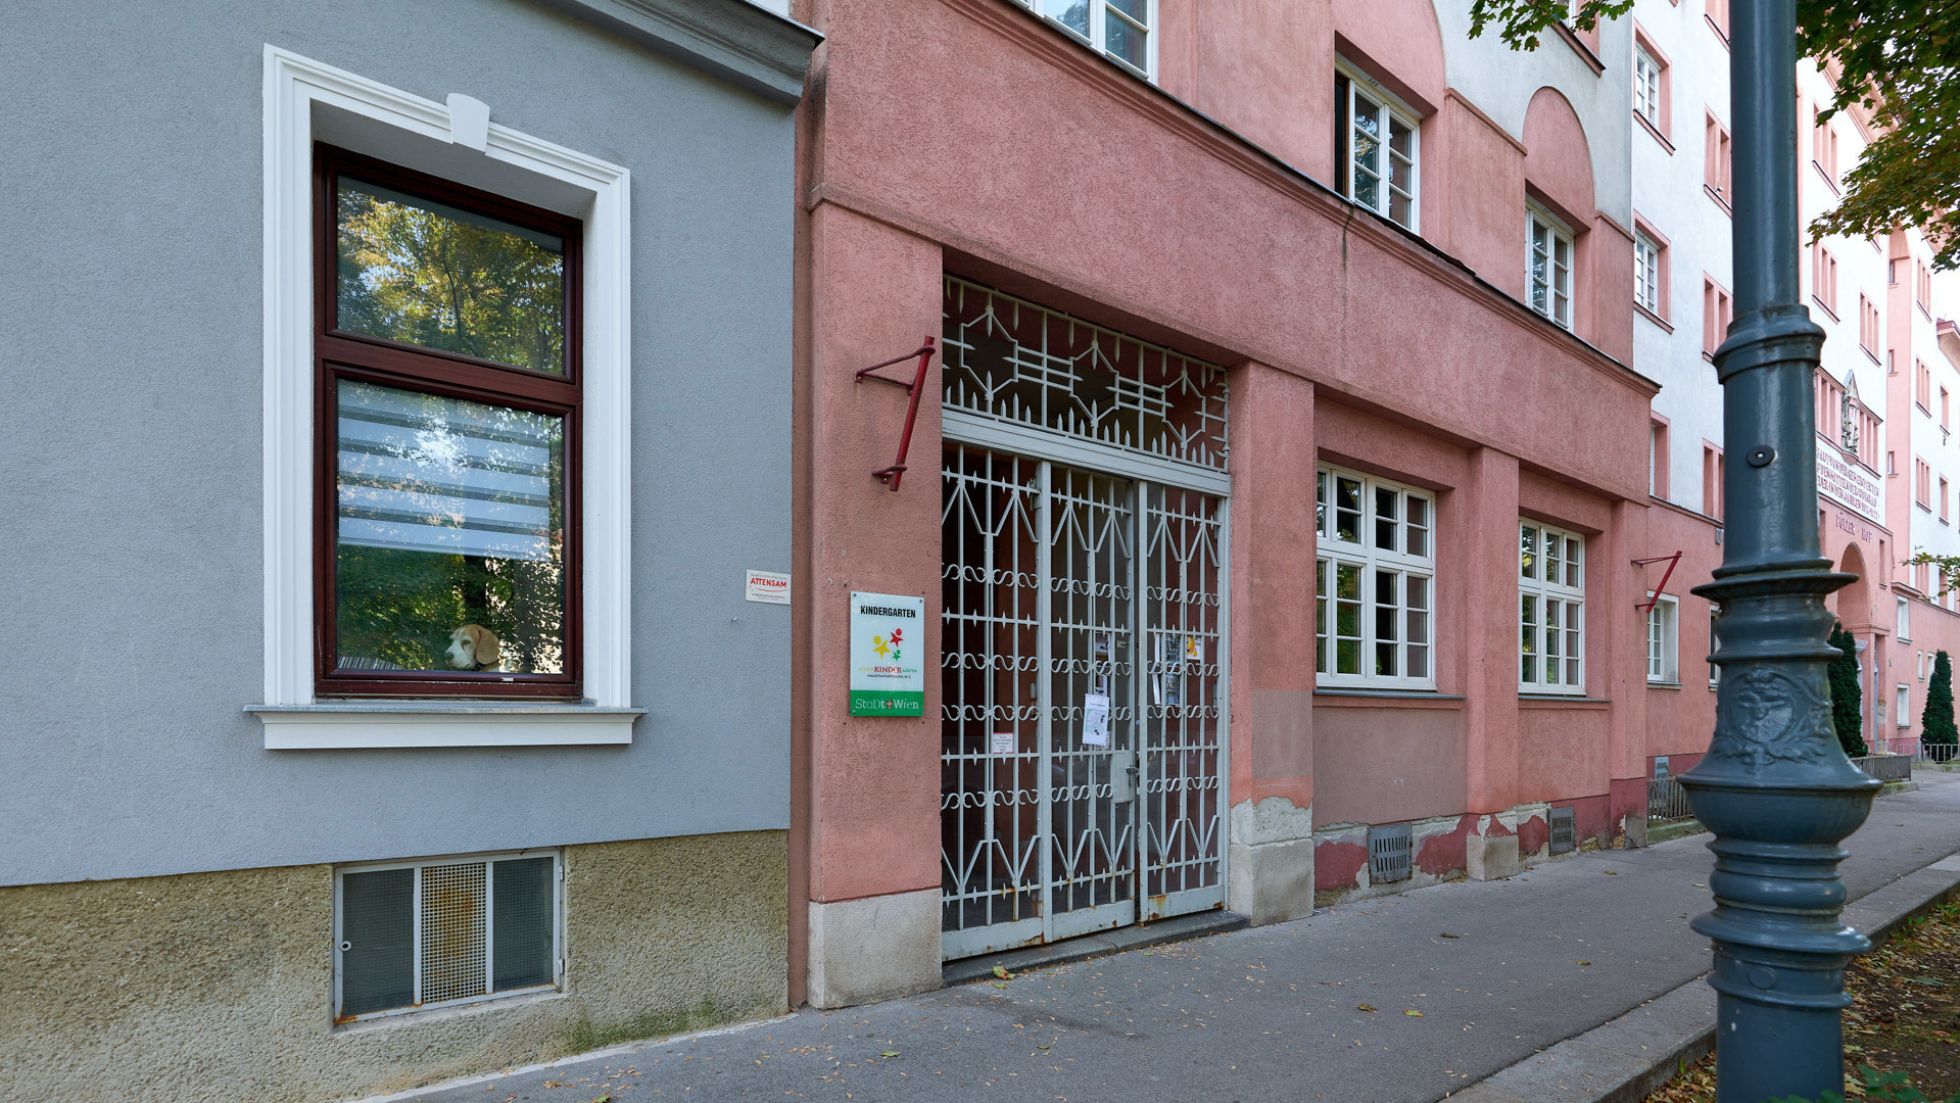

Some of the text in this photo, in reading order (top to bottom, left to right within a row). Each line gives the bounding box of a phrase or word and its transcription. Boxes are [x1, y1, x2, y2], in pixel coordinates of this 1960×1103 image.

[750, 577, 787, 588] ATTENSAM
[860, 605, 916, 618] KINDERGARTEN
[893, 698, 919, 710] Wien
